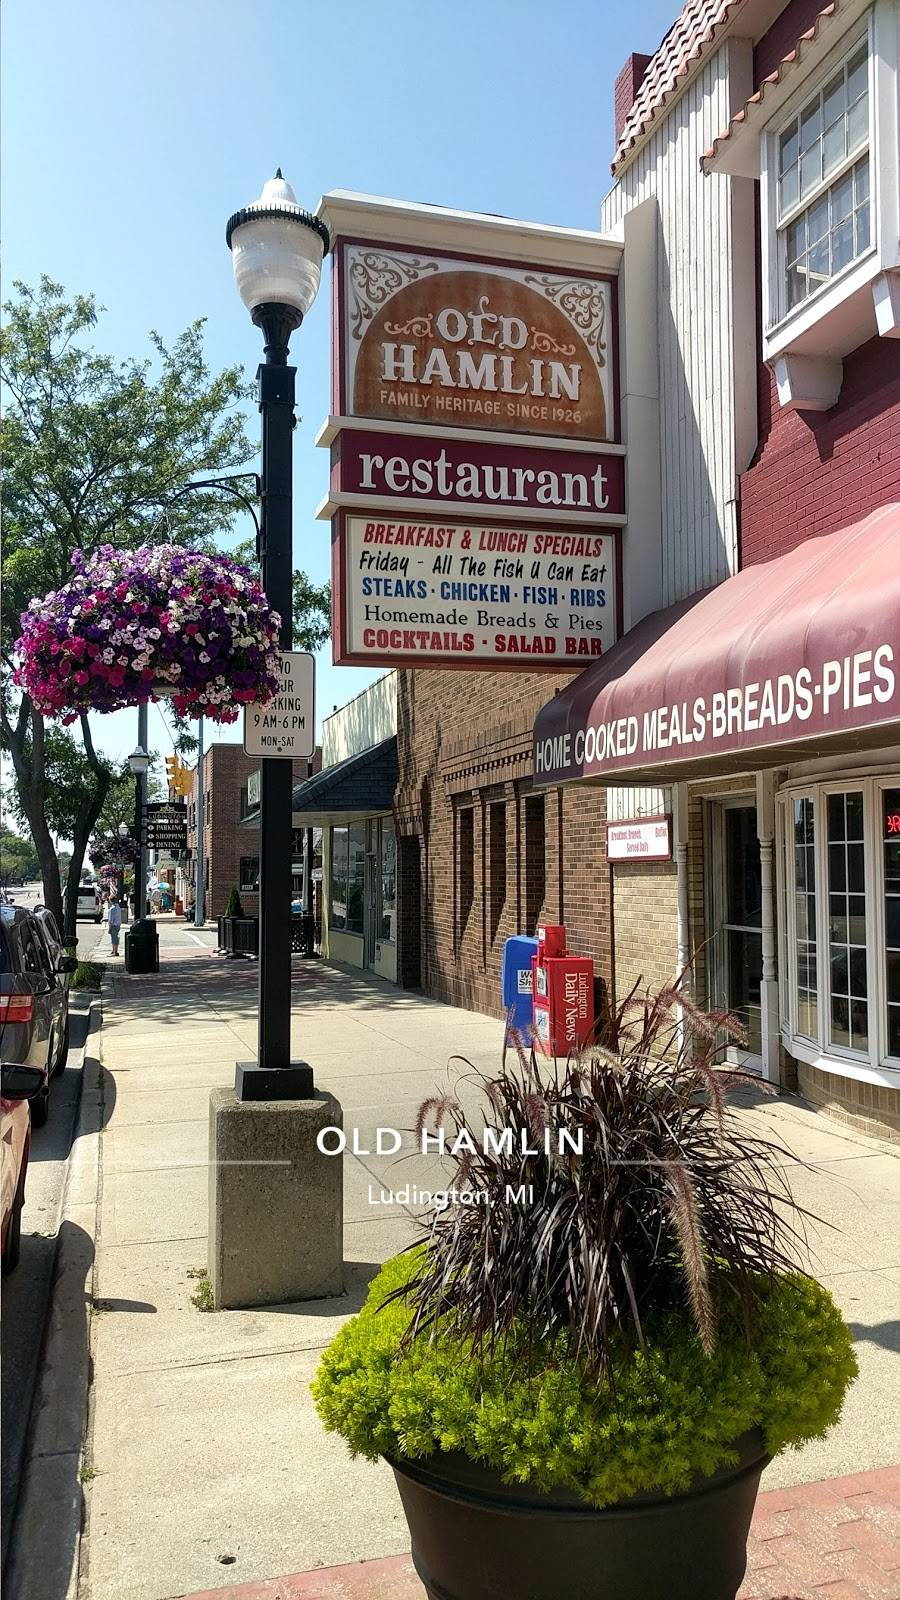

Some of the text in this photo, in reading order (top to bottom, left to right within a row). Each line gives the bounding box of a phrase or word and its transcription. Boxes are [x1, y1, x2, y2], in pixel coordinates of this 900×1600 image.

[436, 296, 530, 350] OLD
[381, 343, 583, 401] HAMLIN
[380, 390, 582, 424] FAMILY HERITAGE SINCE 1926
[358, 449, 610, 509] restaurant
[363, 523, 603, 558] BREAKFAST & LUNCH SPECIALS
[359, 550, 410, 577] Friday
[432, 554, 453, 575] All
[460, 556, 486, 577] The
[493, 558, 524, 579] Fish
[530, 561, 541, 579] U
[547, 562, 574, 581] Can
[581, 564, 607, 583] Eat
[362, 577, 427, 599] STEAKS
[440, 581, 511, 603] CHICKEN
[523, 586, 558, 605] FISH
[570, 588, 606, 607] RIBS
[364, 604, 603, 631] Homemade Breads & Pies
[363, 628, 475, 652] COCKTAILS
[495, 634, 556, 654] SALAD
[564, 637, 602, 656] BAR
[254, 714, 260, 727] 9
[291, 716, 305, 730] PM
[261, 736, 295, 747] MON-SAT
[536, 733, 571, 773] HOME
[575, 716, 638, 766] COOKED
[563, 973, 578, 1042] Daily News
[577, 972, 589, 1019] Ludington
